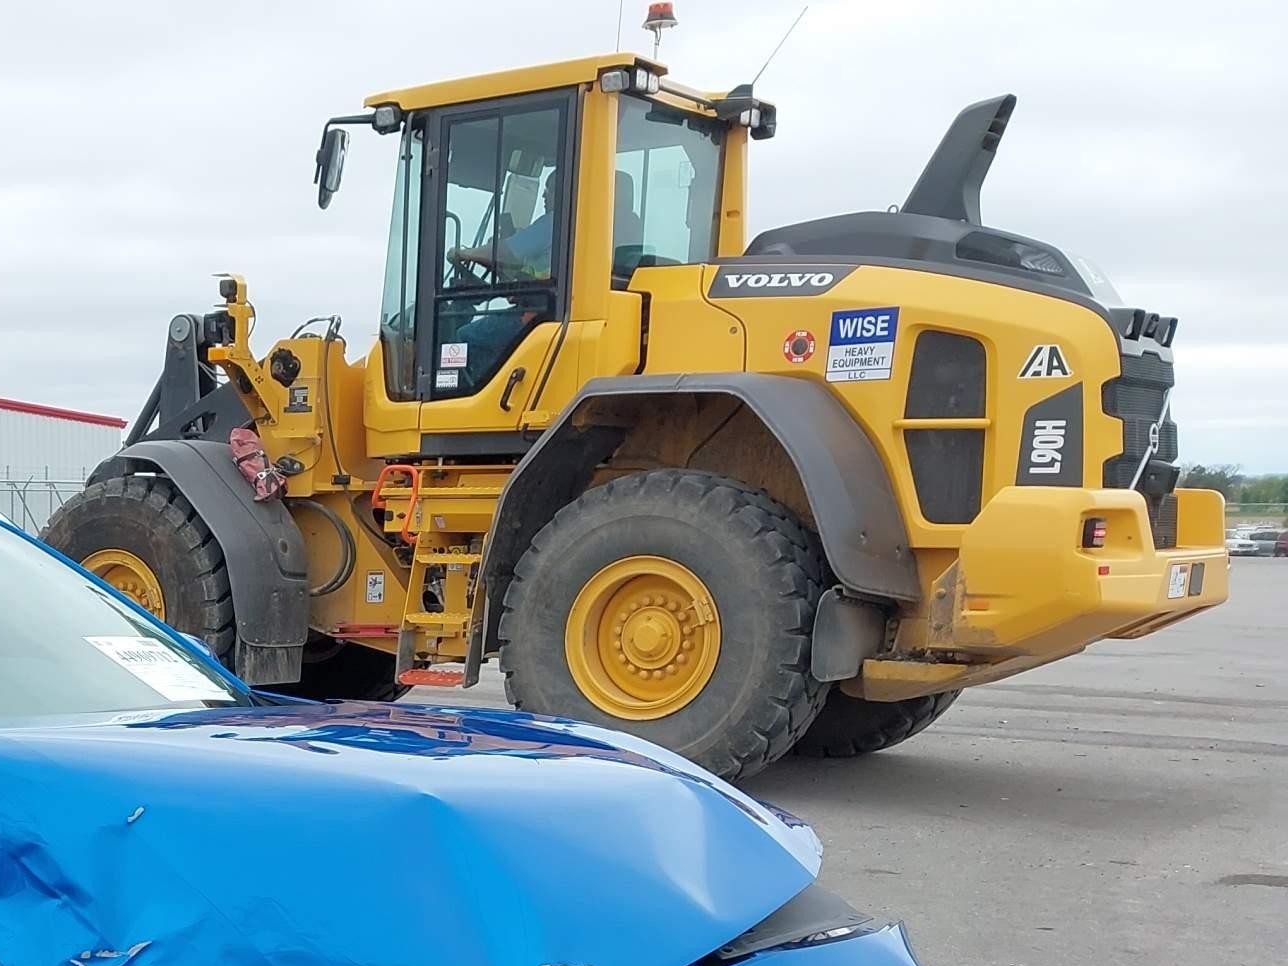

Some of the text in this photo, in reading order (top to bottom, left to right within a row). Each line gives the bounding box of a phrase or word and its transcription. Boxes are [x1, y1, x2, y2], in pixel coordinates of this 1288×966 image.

[725, 273, 834, 288] VOLVO
[838, 315, 890, 339] WISE
[844, 346, 876, 357] HEAVY
[832, 356, 887, 369] EQUIPMENT
[848, 371, 867, 380] LLC
[1028, 419, 1067, 474] L90H
